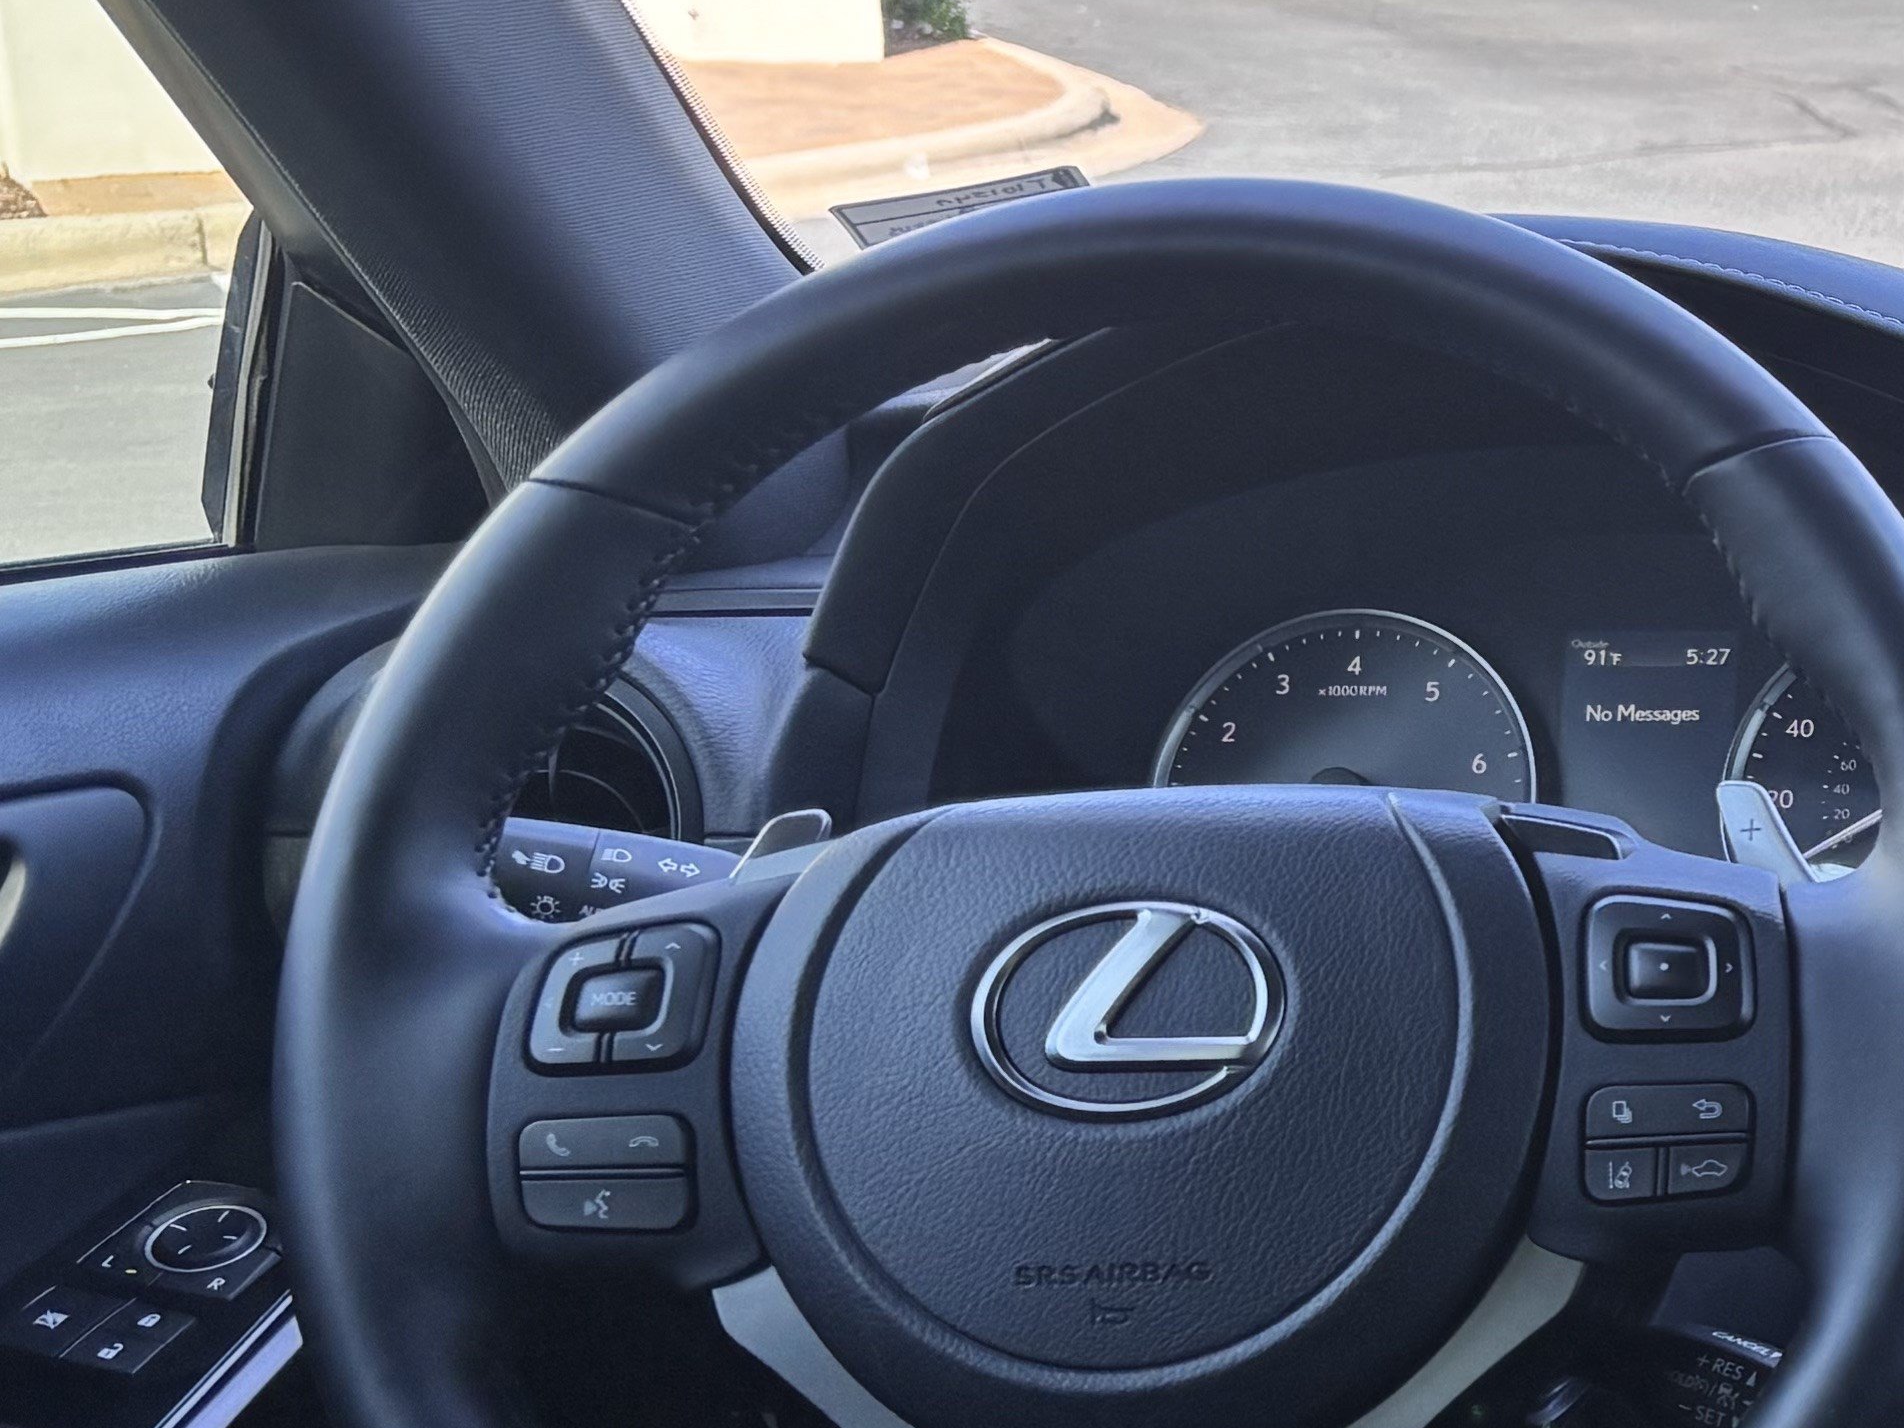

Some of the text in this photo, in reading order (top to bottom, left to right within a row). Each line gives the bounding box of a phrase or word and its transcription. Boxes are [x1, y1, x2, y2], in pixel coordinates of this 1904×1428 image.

[1347, 655, 1362, 675] 4
[1686, 648, 1732, 665] 5:27
[1276, 674, 1290, 695] 3
[1425, 681, 1440, 702] 5
[1586, 704, 1700, 725] No Messages
[1221, 722, 1236, 742] 2
[1785, 719, 1815, 738] 40
[1471, 753, 1487, 774] 6
[1840, 759, 1857, 772] 60
[1832, 783, 1850, 795] 40
[1833, 808, 1850, 820] 20
[591, 991, 637, 1006] MODE
[101, 1254, 115, 1269] L
[206, 1277, 226, 1291] R
